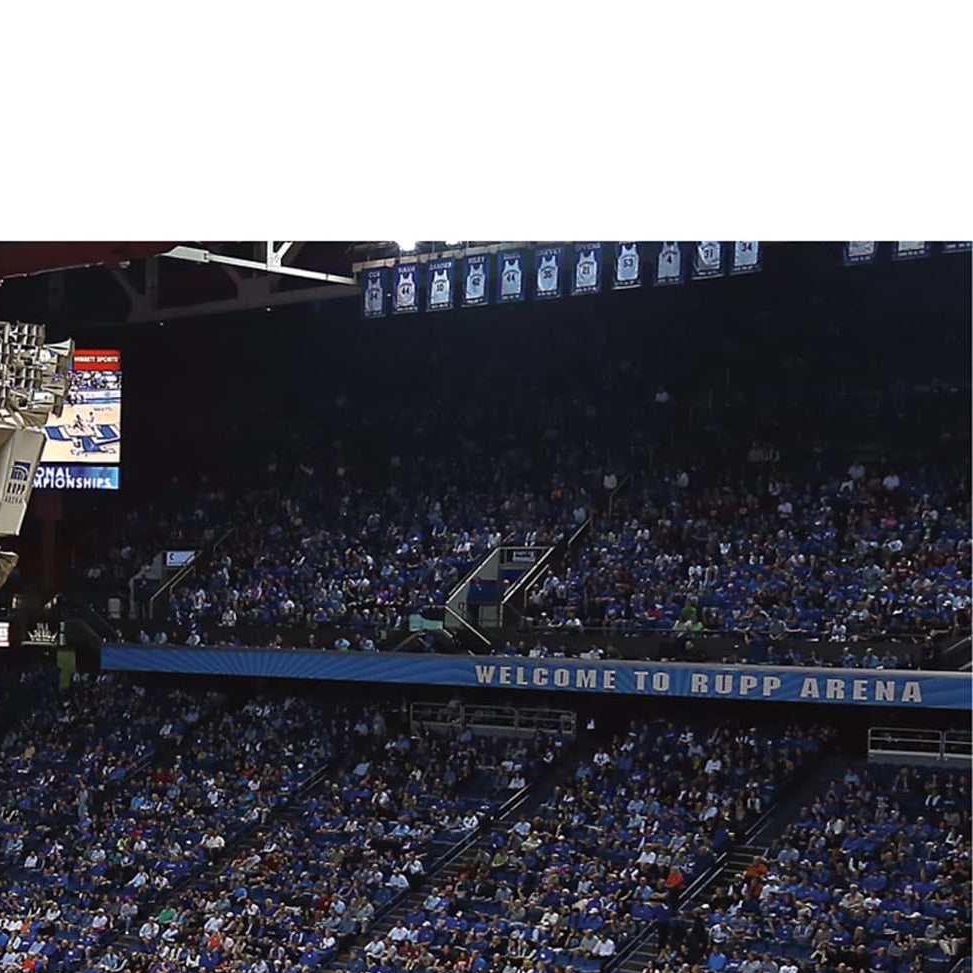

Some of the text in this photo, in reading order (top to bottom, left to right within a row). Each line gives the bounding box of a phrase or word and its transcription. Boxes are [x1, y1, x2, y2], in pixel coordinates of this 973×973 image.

[35, 467, 72, 480] ONAL
[33, 477, 114, 489] MPIONSHIPS
[475, 665, 922, 703] WELCOME TO RUPP ARENA
